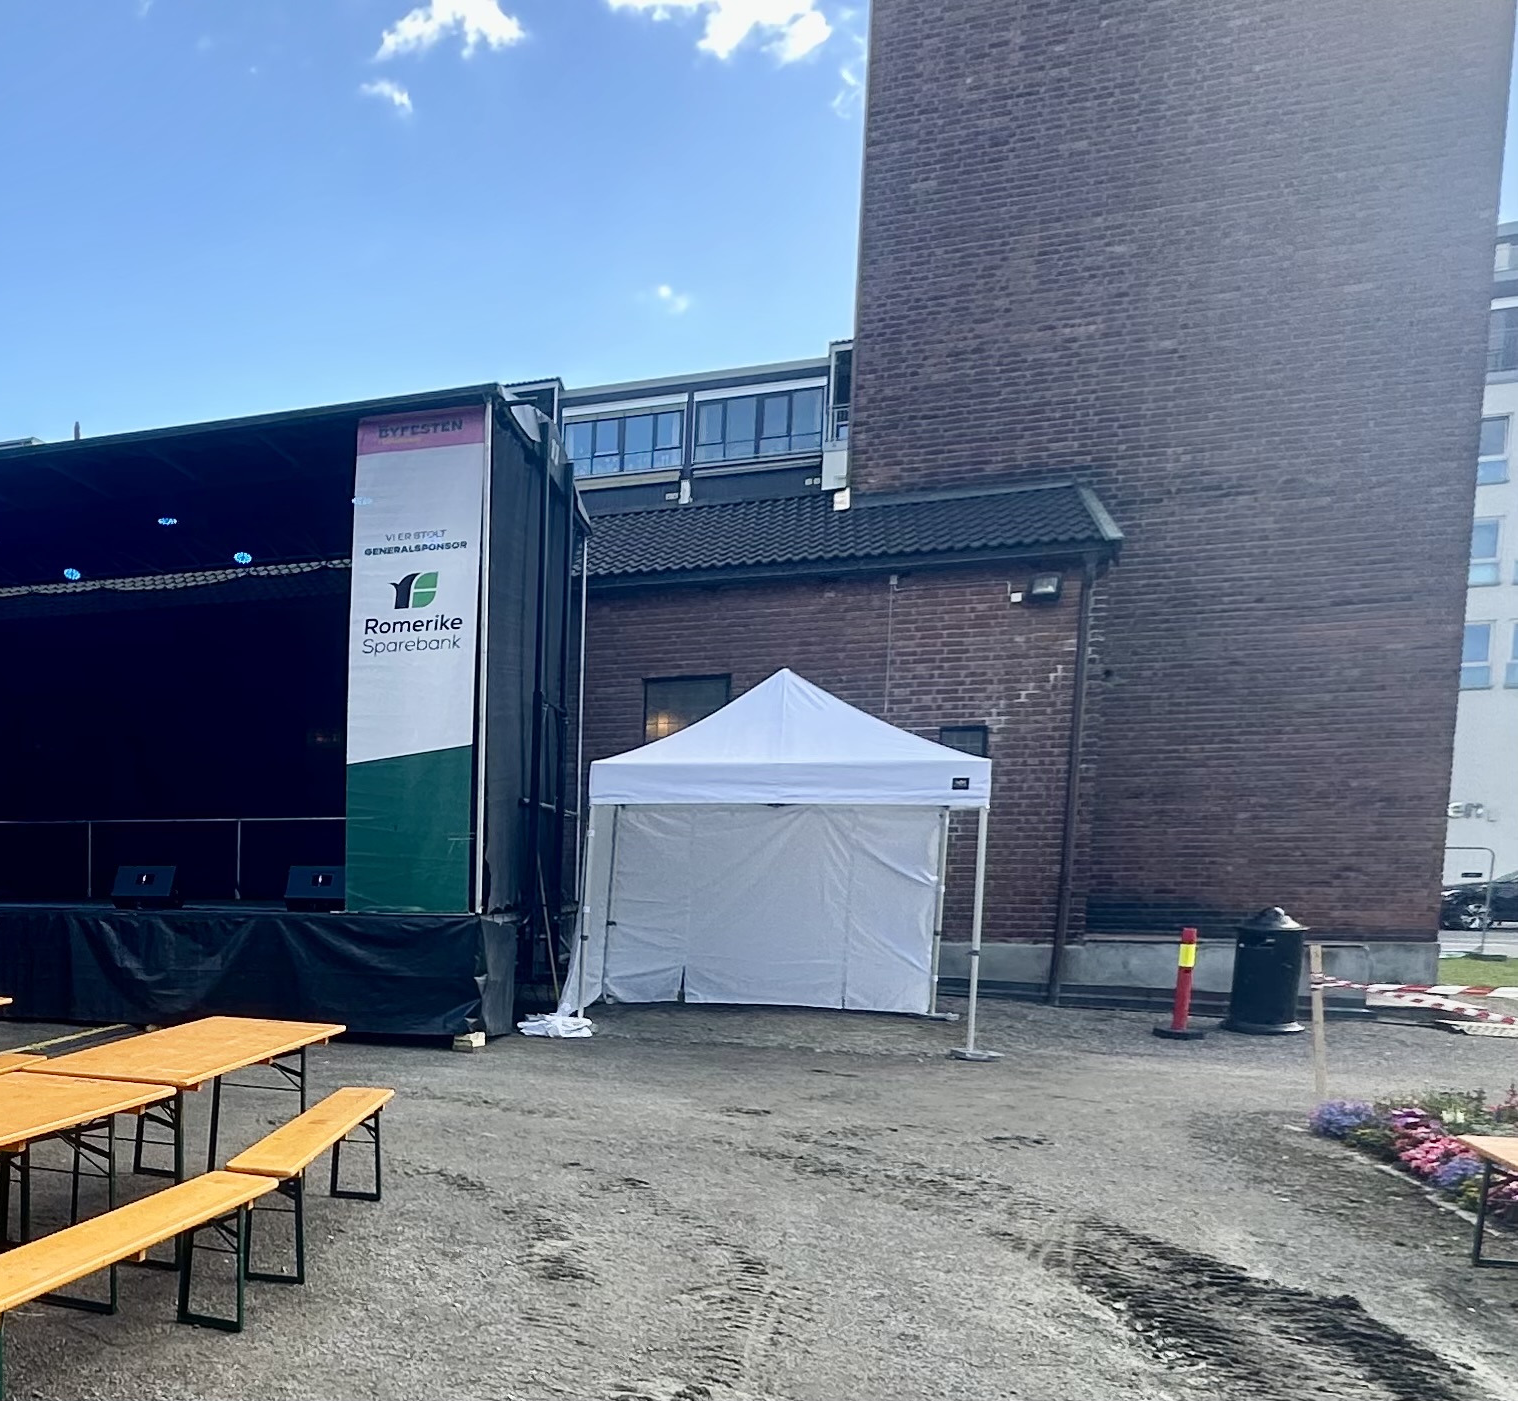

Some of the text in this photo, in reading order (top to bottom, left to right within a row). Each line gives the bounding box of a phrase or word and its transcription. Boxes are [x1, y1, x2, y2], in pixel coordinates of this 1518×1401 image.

[378, 419, 463, 438] BYFESTEN
[385, 533, 396, 542] VI
[398, 532, 412, 541] ER
[364, 541, 468, 556] GENERALSPONSOR
[364, 614, 463, 635] Romerike
[361, 634, 462, 657] Sparebank
